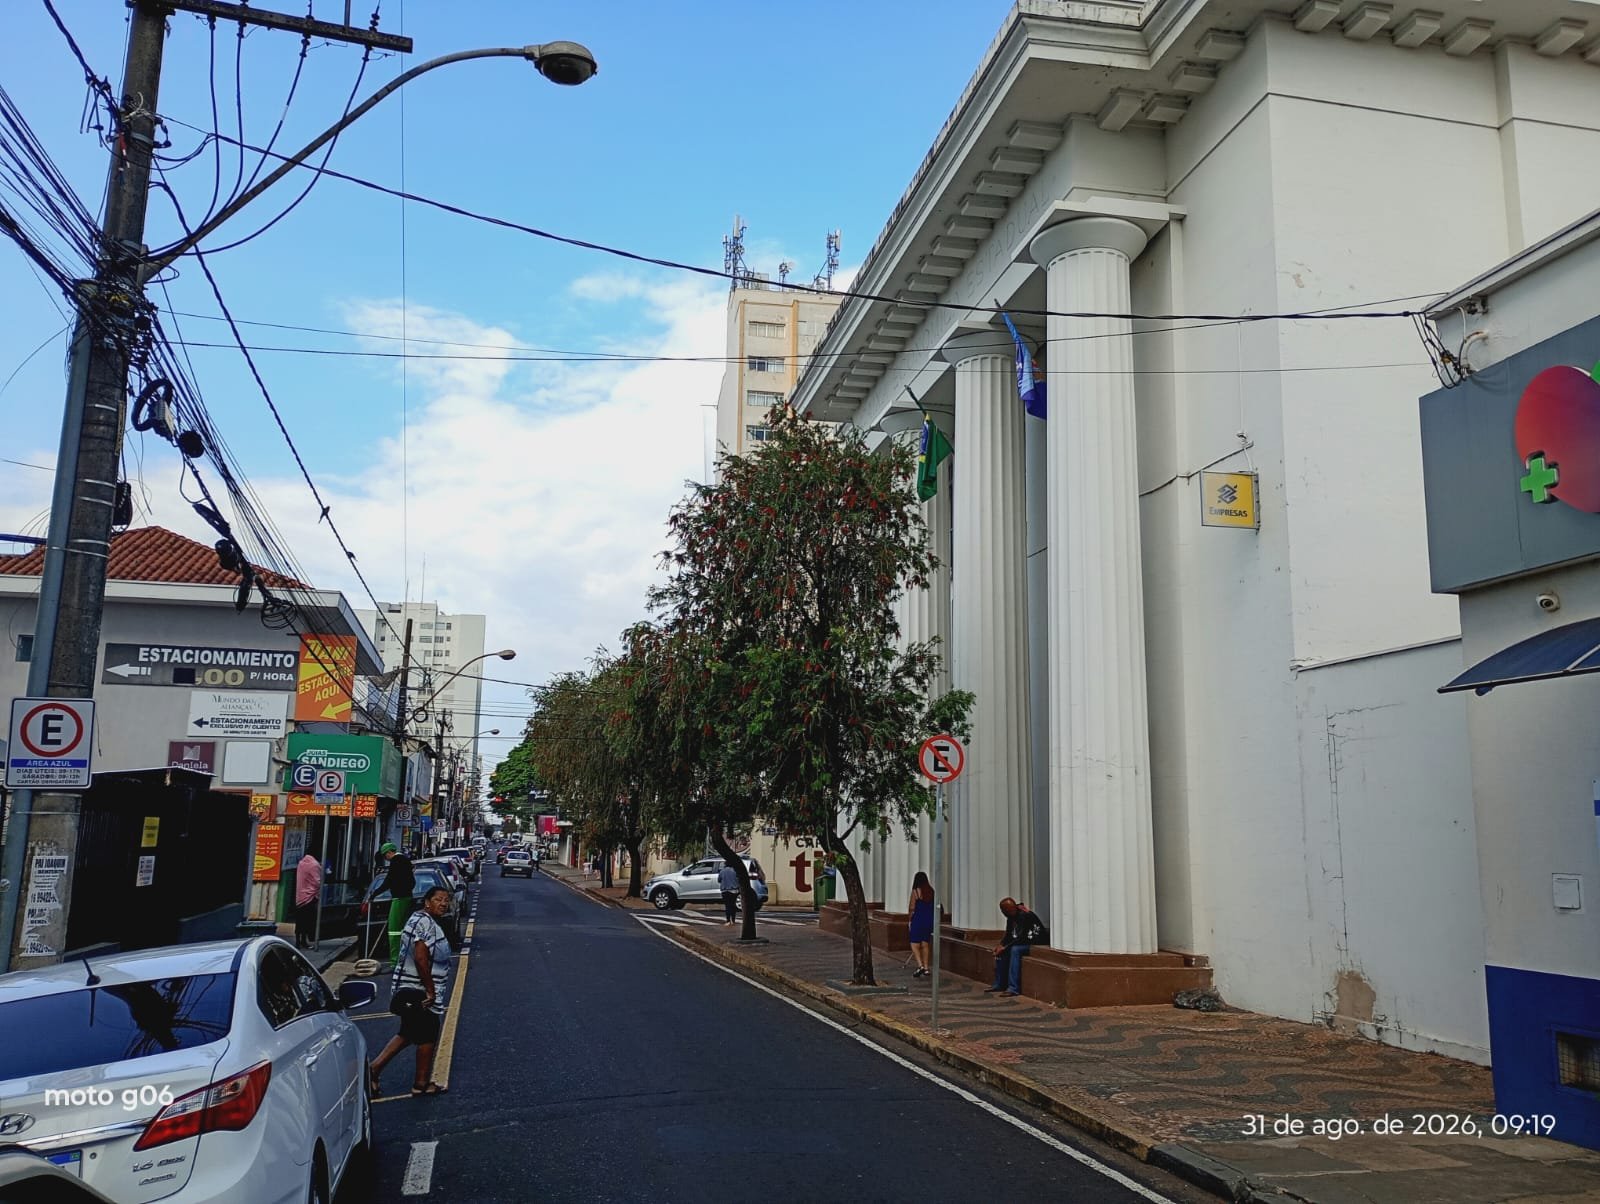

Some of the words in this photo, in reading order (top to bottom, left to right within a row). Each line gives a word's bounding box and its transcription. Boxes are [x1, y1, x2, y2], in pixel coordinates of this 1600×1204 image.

[1209, 506, 1248, 517] EMPRESAS
[138, 647, 295, 668] ESTACIONAMENTO
[250, 671, 260, 680] P/
[263, 672, 294, 681] HORA
[314, 683, 340, 703] AQUI
[210, 717, 282, 725] ESTACIONAMENTO
[40, 714, 64, 745] E
[301, 756, 367, 769] SANDIEGO
[933, 745, 950, 773] E
[300, 768, 313, 783] E
[326, 776, 336, 789] E
